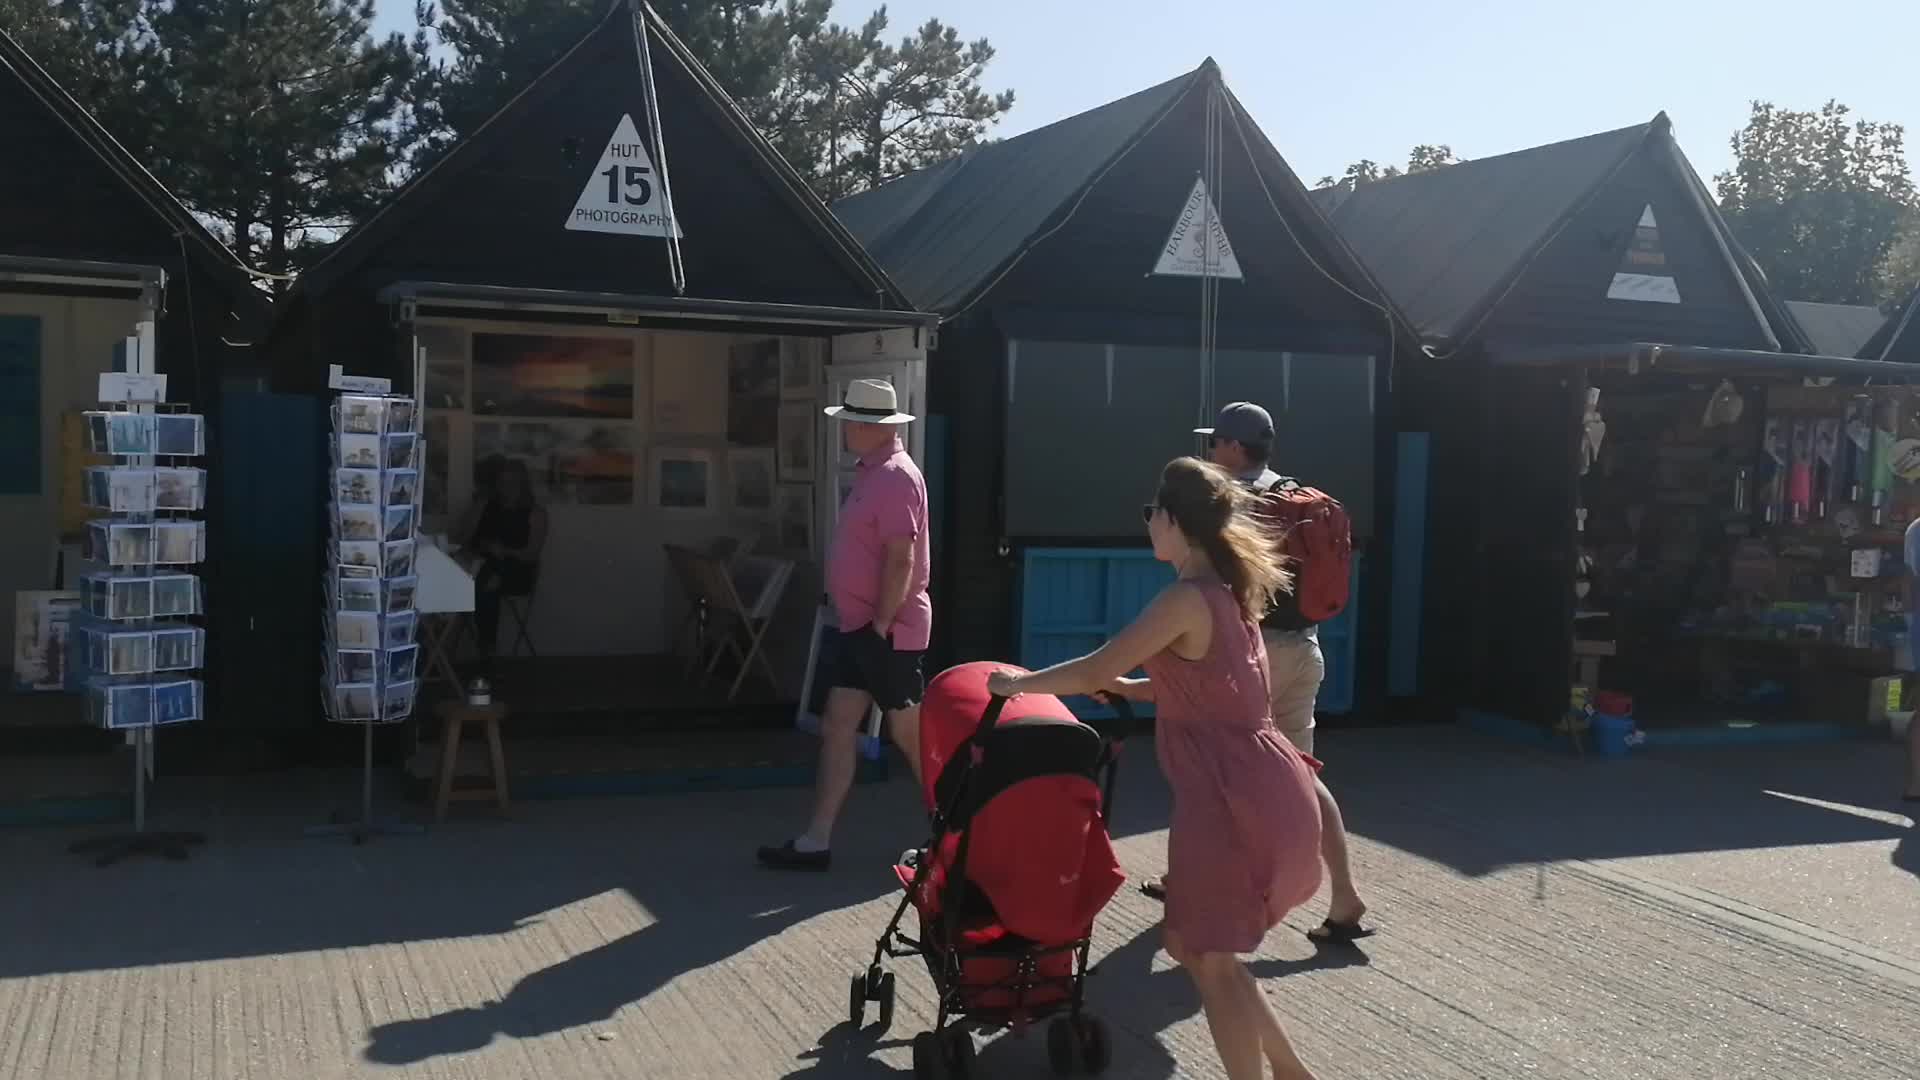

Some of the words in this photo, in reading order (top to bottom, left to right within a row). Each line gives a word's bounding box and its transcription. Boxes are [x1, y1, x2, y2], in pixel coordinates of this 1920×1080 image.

[611, 143, 641, 159] HUT
[601, 164, 652, 206] 15
[575, 208, 673, 227] PHOTOGRAPHY
[1167, 190, 1204, 256] HARBOUR
